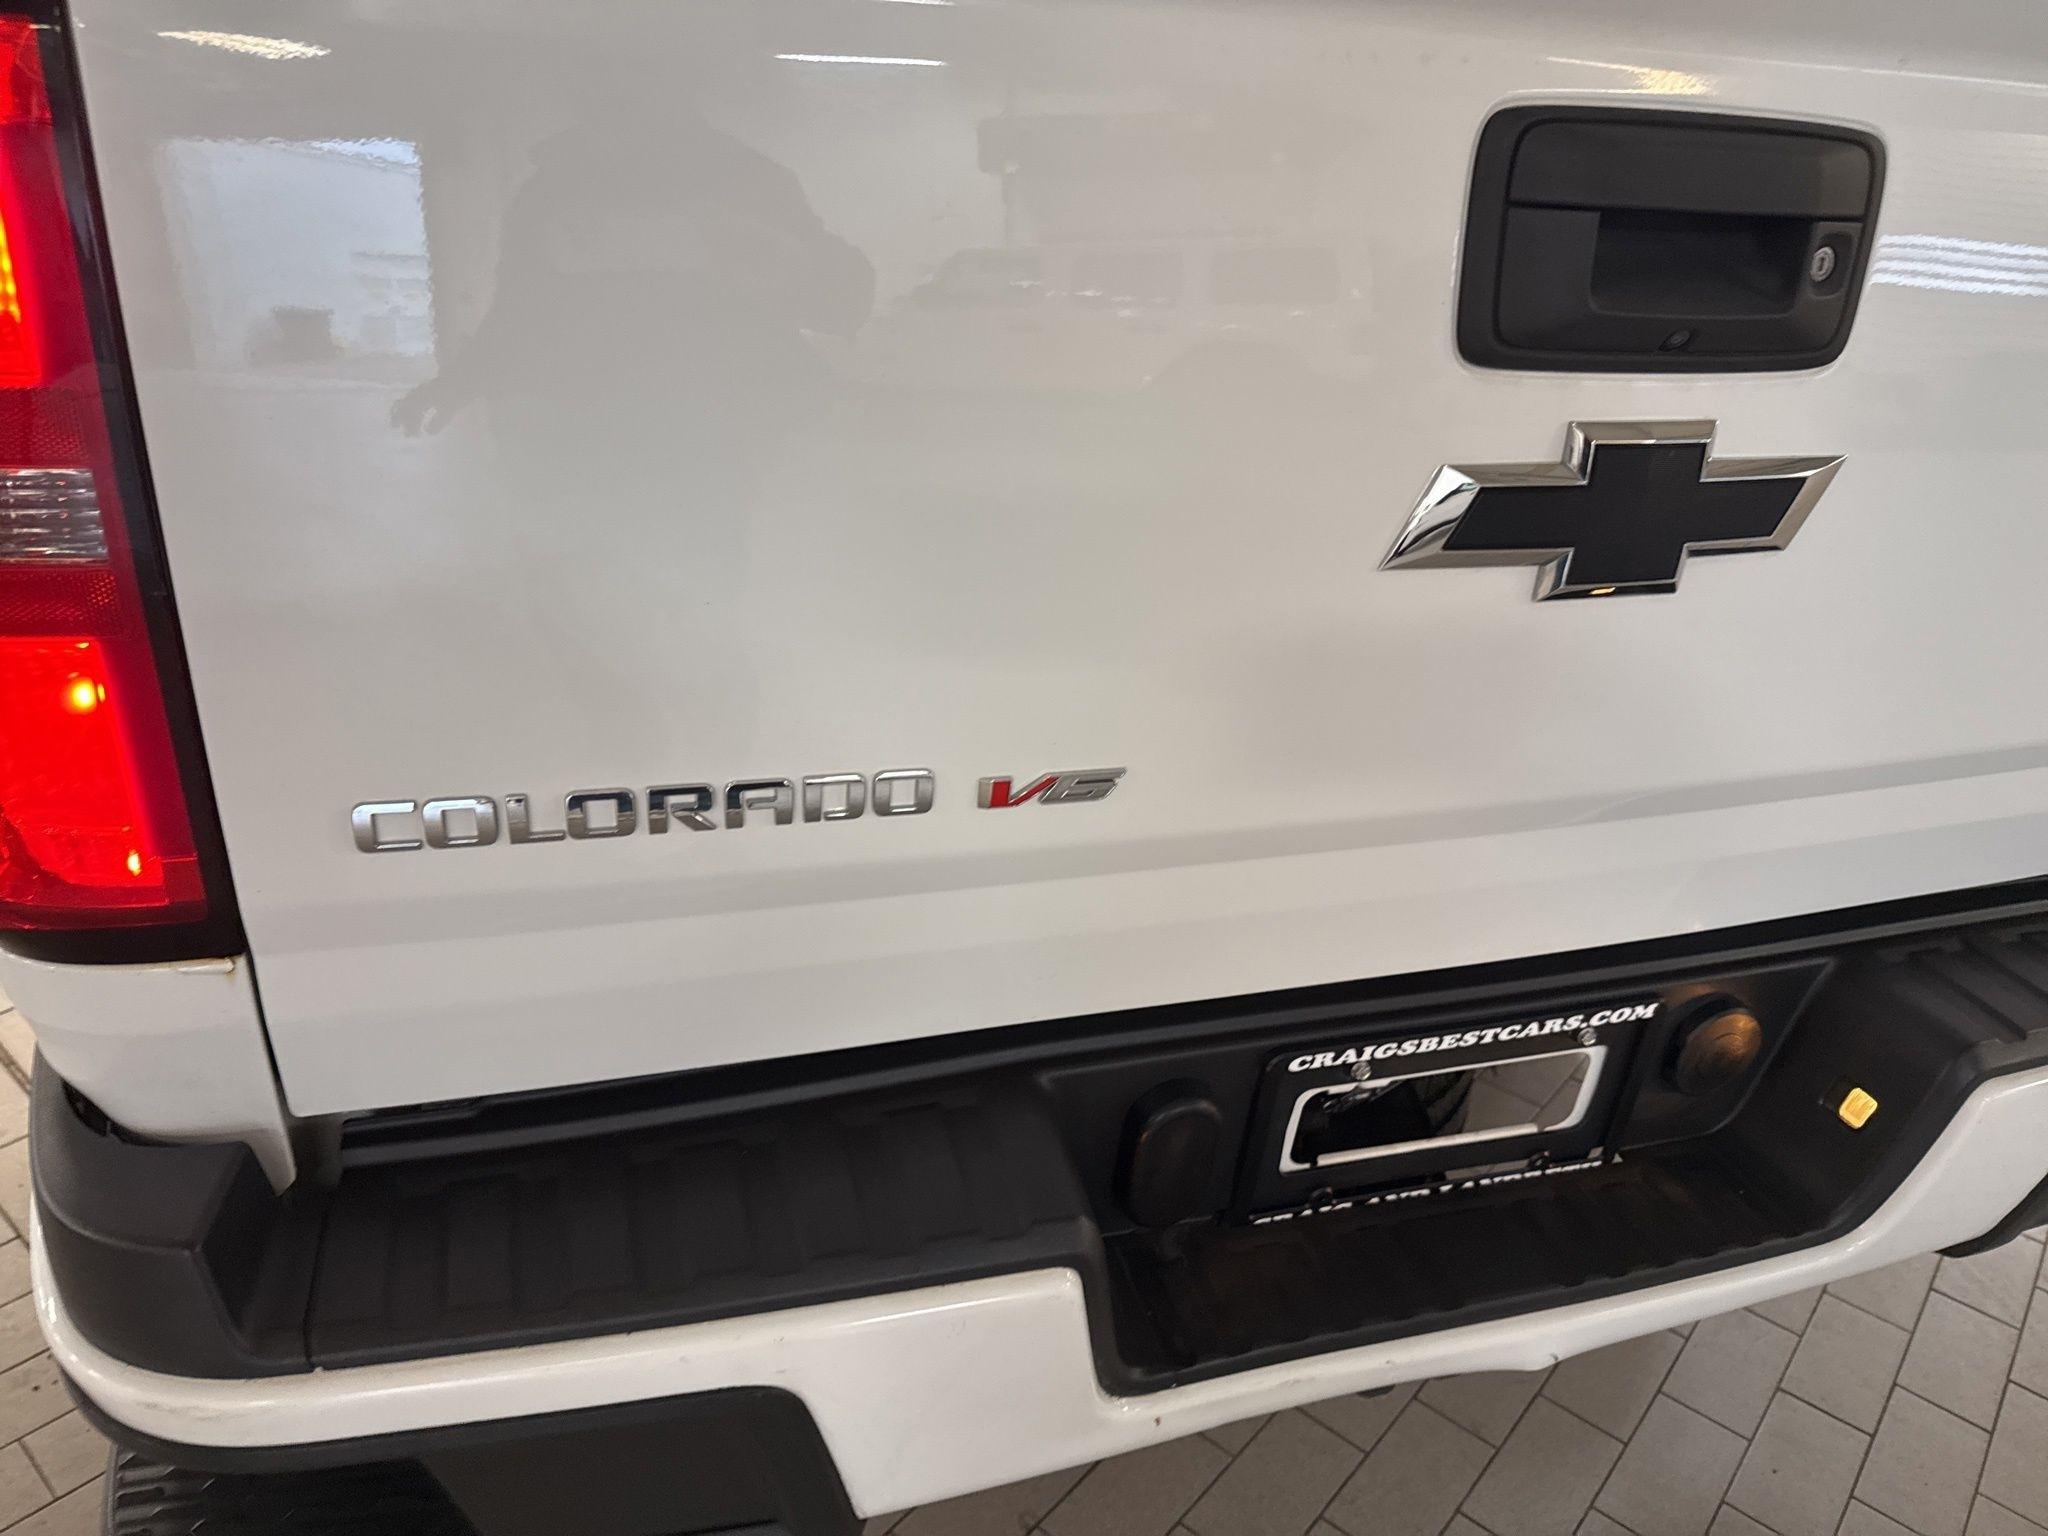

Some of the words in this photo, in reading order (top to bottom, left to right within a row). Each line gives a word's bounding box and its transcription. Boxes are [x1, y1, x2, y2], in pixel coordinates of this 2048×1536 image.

[352, 768, 935, 853] COLORADO
[978, 766, 1127, 809] V6
[1288, 1002, 1659, 1073] CRAIGSBESTCARS.COM
